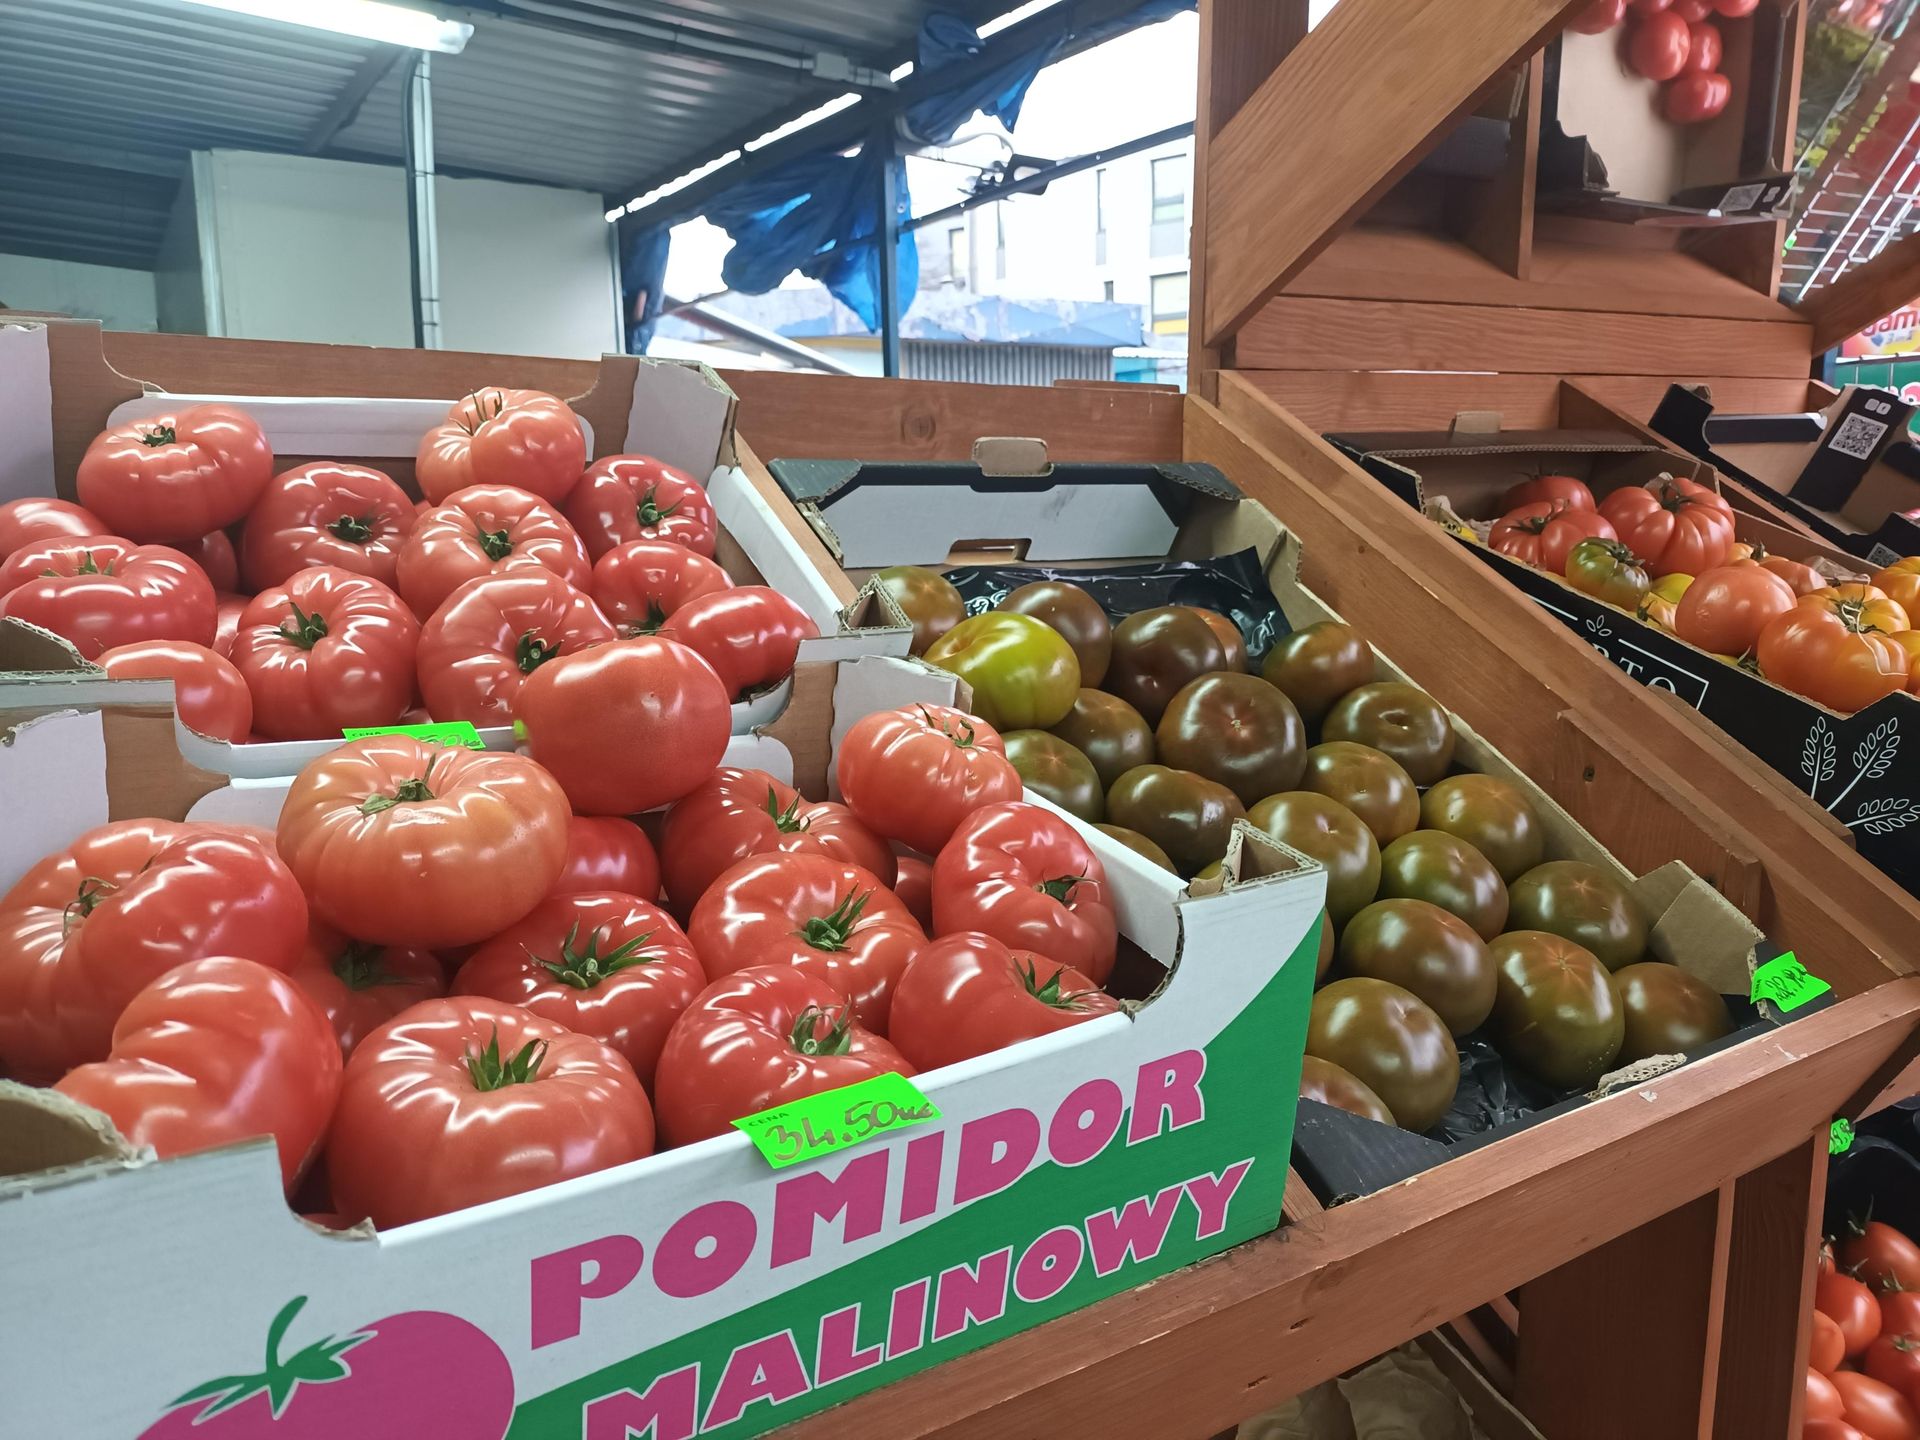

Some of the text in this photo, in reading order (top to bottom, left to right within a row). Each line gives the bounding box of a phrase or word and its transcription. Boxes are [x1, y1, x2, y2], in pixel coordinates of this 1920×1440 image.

[531, 1049, 1206, 1350] POMIDOR
[748, 1111, 790, 1128] CENA
[583, 1156, 1256, 1440] MALINOWY
